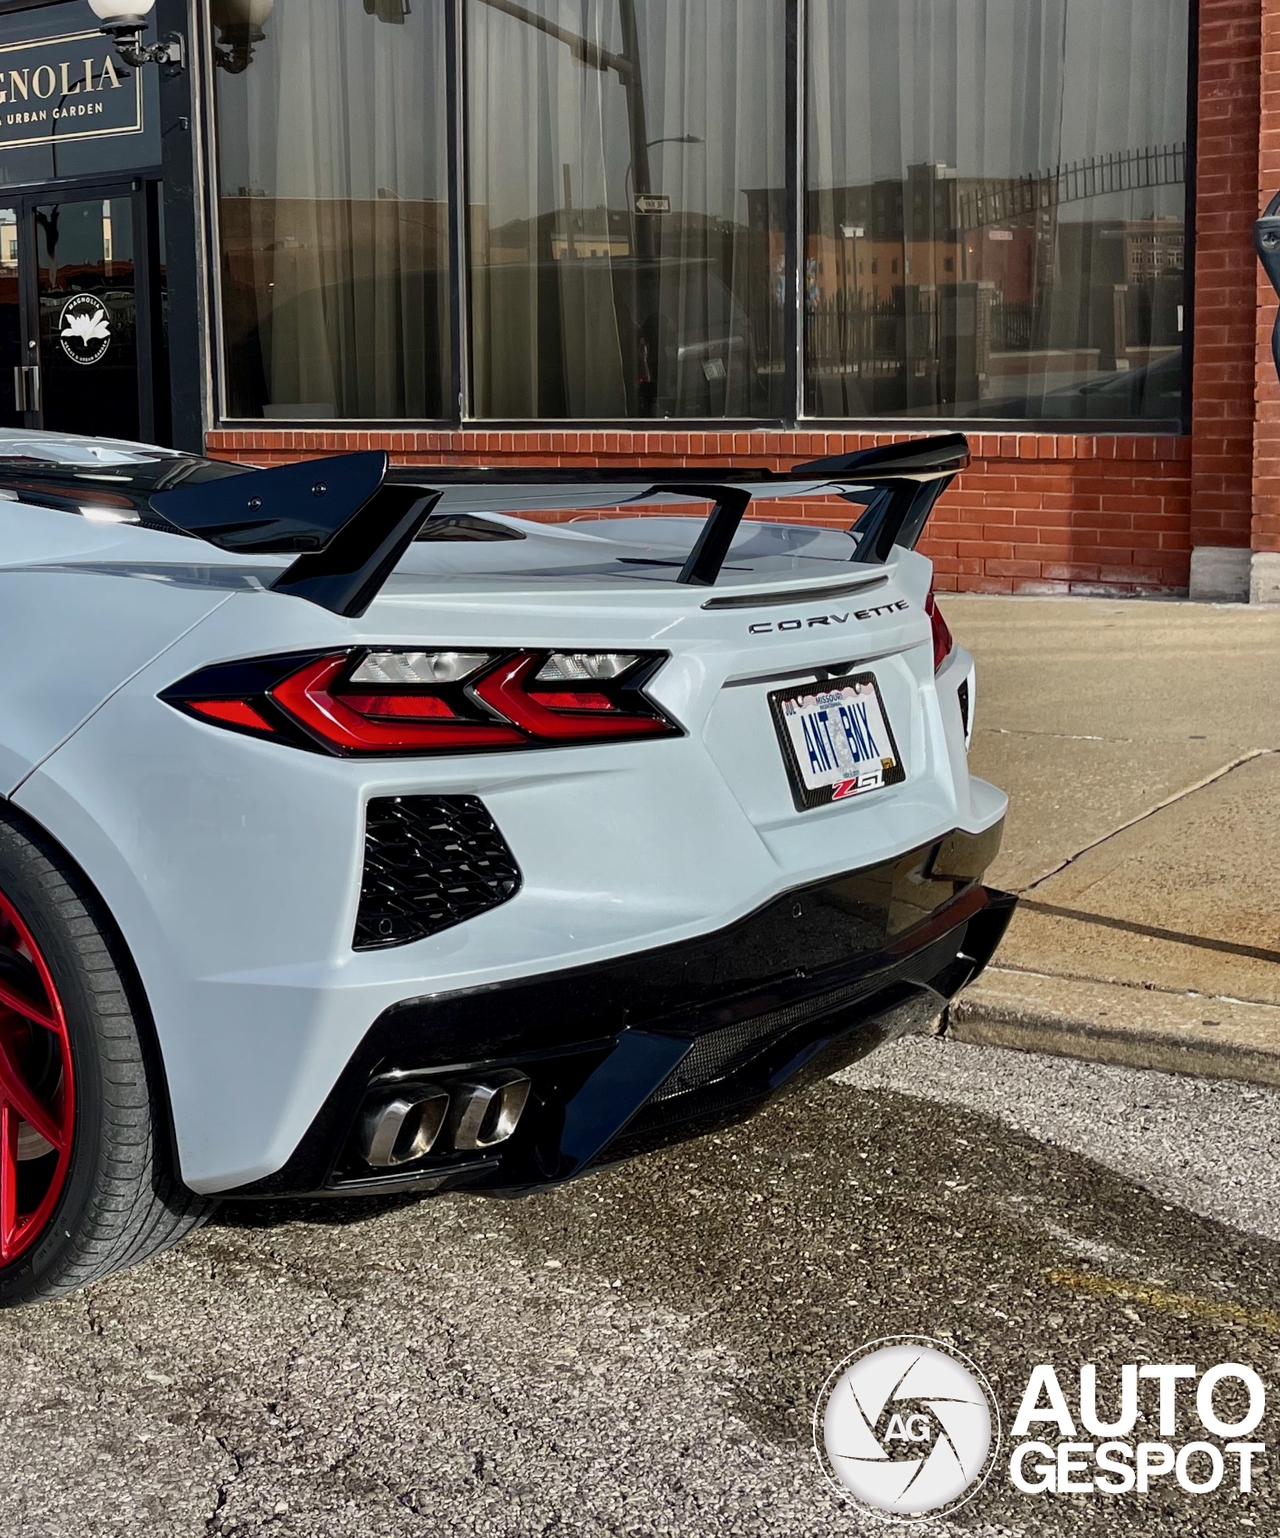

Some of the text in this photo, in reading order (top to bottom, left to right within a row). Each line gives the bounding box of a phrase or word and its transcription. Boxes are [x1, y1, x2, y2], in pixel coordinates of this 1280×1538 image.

[7, 109, 48, 125] URBAN
[52, 102, 104, 119] GARDEN
[68, 297, 100, 310] MAGNOLIA
[748, 599, 910, 634] CORVETTE
[816, 692, 843, 705] MISSOURI
[801, 702, 880, 774] ANT BNX
[832, 770, 885, 800] Z51
